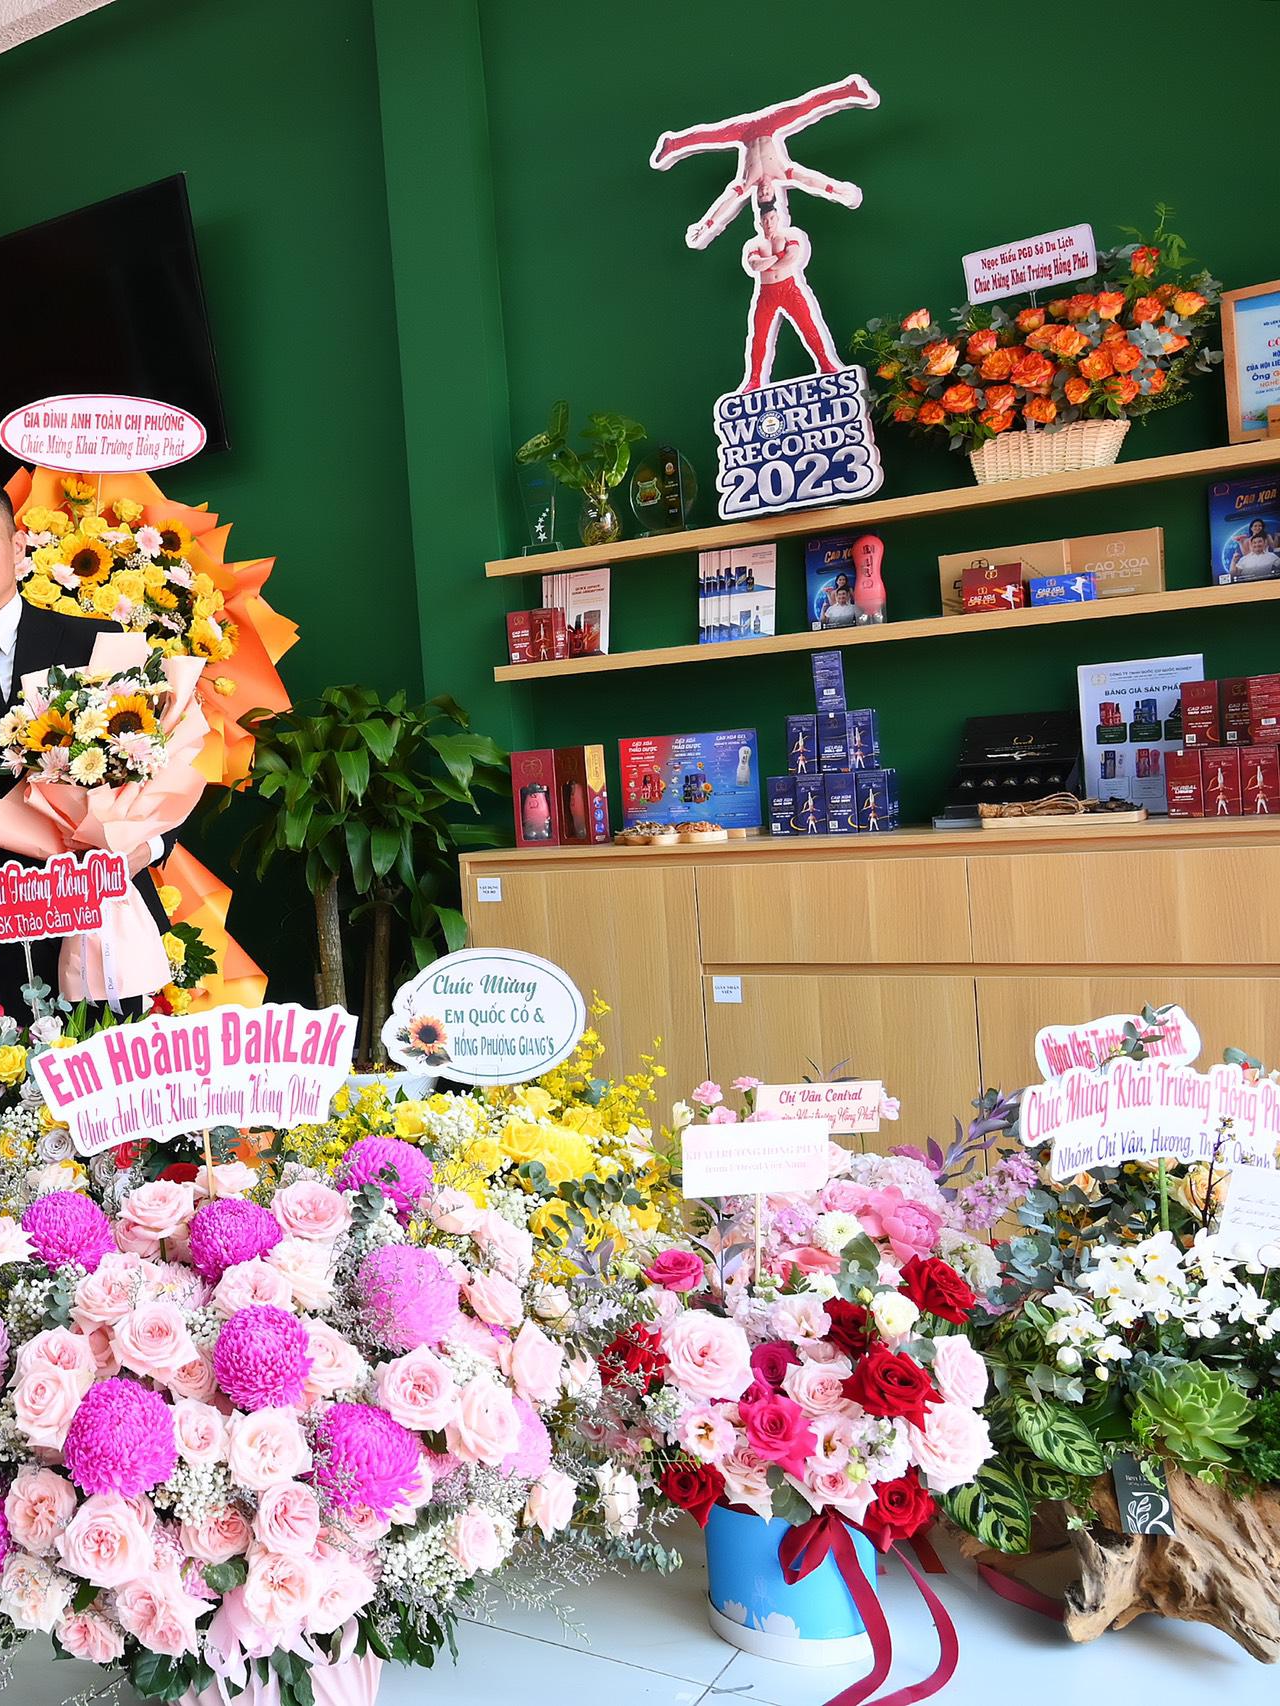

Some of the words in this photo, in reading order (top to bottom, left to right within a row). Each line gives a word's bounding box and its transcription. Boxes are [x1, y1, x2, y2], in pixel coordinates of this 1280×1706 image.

[1045, 241, 1056, 252] Du
[1057, 236, 1074, 252] Lịch
[974, 276, 990, 294] Chúc
[992, 271, 1010, 292] Mừng
[1010, 266, 1026, 285] Khai
[1027, 263, 1052, 282] Trương
[1053, 252, 1072, 276] Hồng
[1072, 250, 1089, 270] Phát
[719, 370, 858, 420] GUINESS
[23, 412, 40, 429] GIA
[43, 408, 67, 429] ĐÌNH
[71, 413, 91, 430] ANH
[95, 409, 121, 431] TOÀN
[124, 414, 141, 434] CHỊ
[144, 412, 185, 432] PHƯƠNG
[20, 434, 44, 454] Chúc
[46, 434, 72, 459] Mừng
[75, 435, 98, 455] Khai
[100, 436, 134, 459] Trương
[136, 433, 161, 460] Hồng
[162, 437, 185, 457] Phát
[725, 421, 864, 470] RECORDS
[722, 447, 873, 516] 2023
[1084, 562, 1114, 573] CAO
[1119, 557, 1150, 569] XOA
[6, 868, 53, 909] Trương
[52, 862, 90, 904] Hồng
[90, 858, 124, 900] Phát
[14, 909, 43, 934] Thảo
[45, 905, 72, 929] Cầm
[73, 905, 100, 925] Viên
[432, 973, 474, 995] Chúc
[480, 973, 538, 1002] Mừng
[445, 1008, 464, 1024] EM
[469, 1001, 506, 1027] QUỐC
[533, 1007, 545, 1024] &
[39, 1052, 103, 1108] Em
[105, 1021, 211, 1086] Hoàng
[221, 1009, 347, 1068] ĐakLak
[454, 1027, 478, 1057] HỒNG
[519, 1034, 555, 1056] GIANG'S
[77, 1108, 110, 1150] Chúc
[110, 1104, 140, 1137] Anh
[141, 1087, 164, 1136] Chị
[166, 1079, 198, 1126] Khai
[200, 1077, 245, 1128] Trương
[248, 1068, 283, 1124] Hồng
[287, 1073, 322, 1123] Phát
[779, 1090, 797, 1107] Chị
[800, 1088, 822, 1103] Vân
[825, 1087, 863, 1102] Central
[1027, 1084, 1063, 1141] Chúc
[1066, 1074, 1110, 1128] Mừng
[1113, 1064, 1153, 1111] Khai
[1156, 1062, 1211, 1125] Trương
[1215, 1069, 1258, 1137] Hồng
[1058, 1141, 1093, 1175] Nhóm
[1097, 1131, 1118, 1166] Chị
[1120, 1127, 1147, 1158] Vân,
[1150, 1126, 1194, 1159] Hương,
